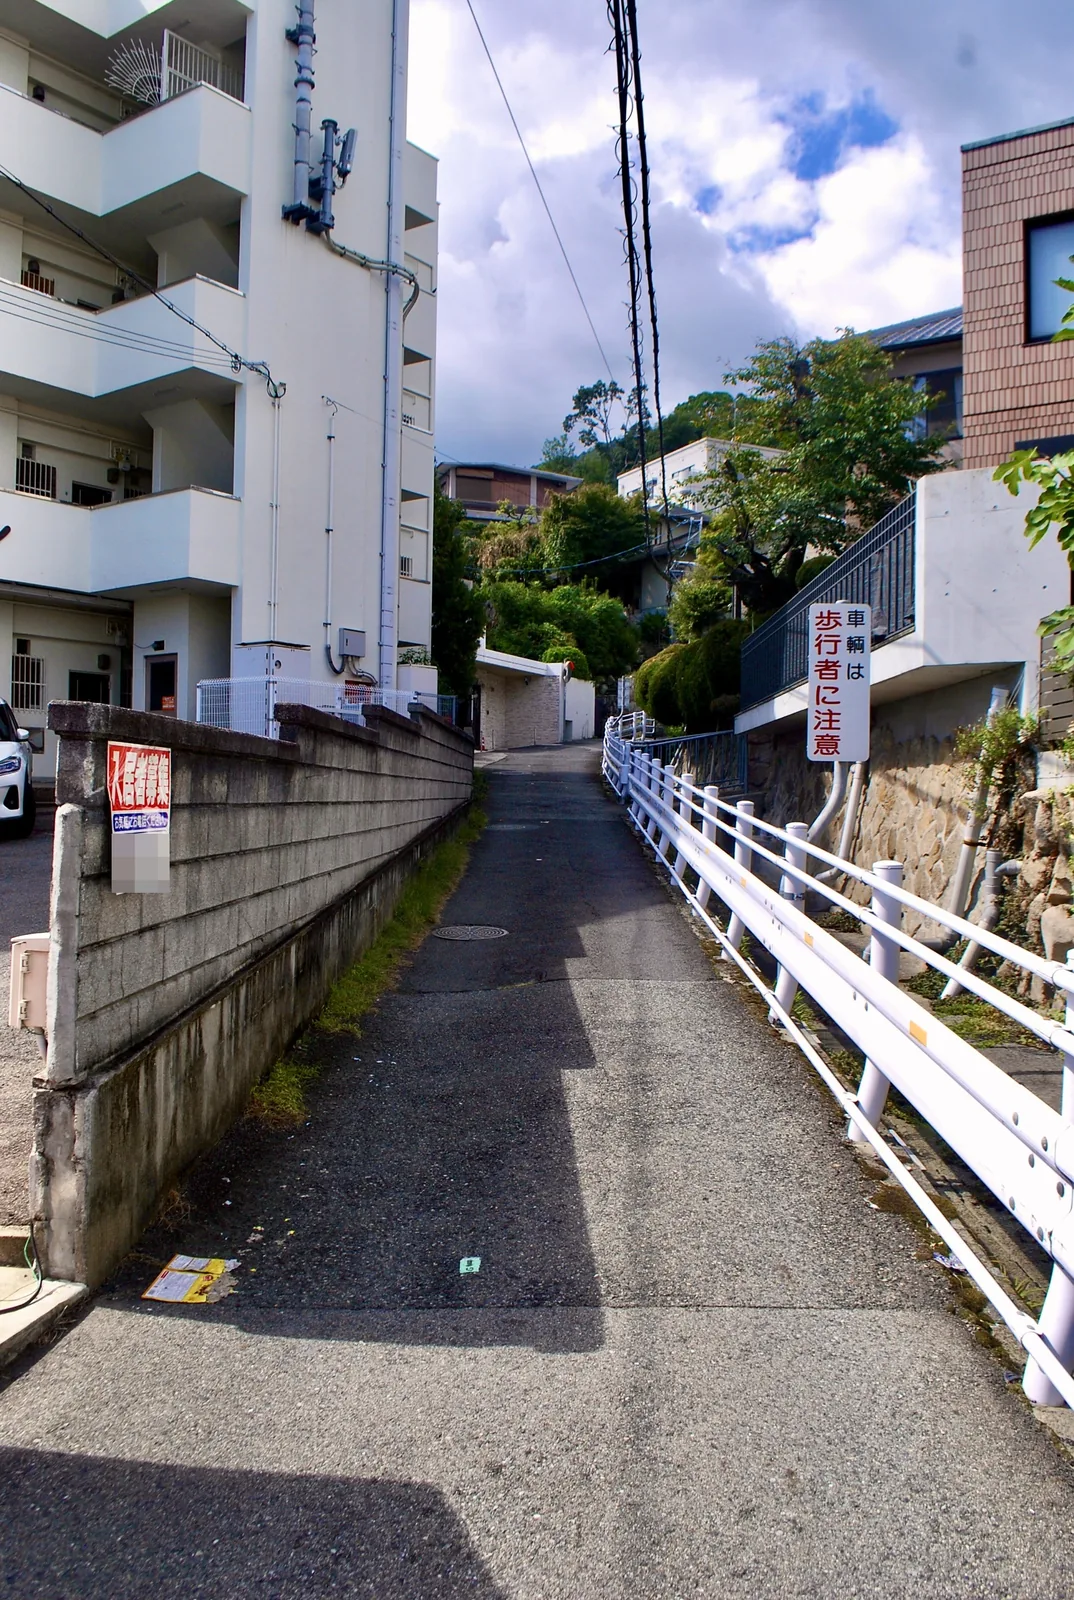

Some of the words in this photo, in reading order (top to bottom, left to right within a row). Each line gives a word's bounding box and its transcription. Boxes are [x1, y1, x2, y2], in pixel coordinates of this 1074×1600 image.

[814, 610, 842, 755] 歩行者に注意
[112, 751, 168, 805] 入居者募集
